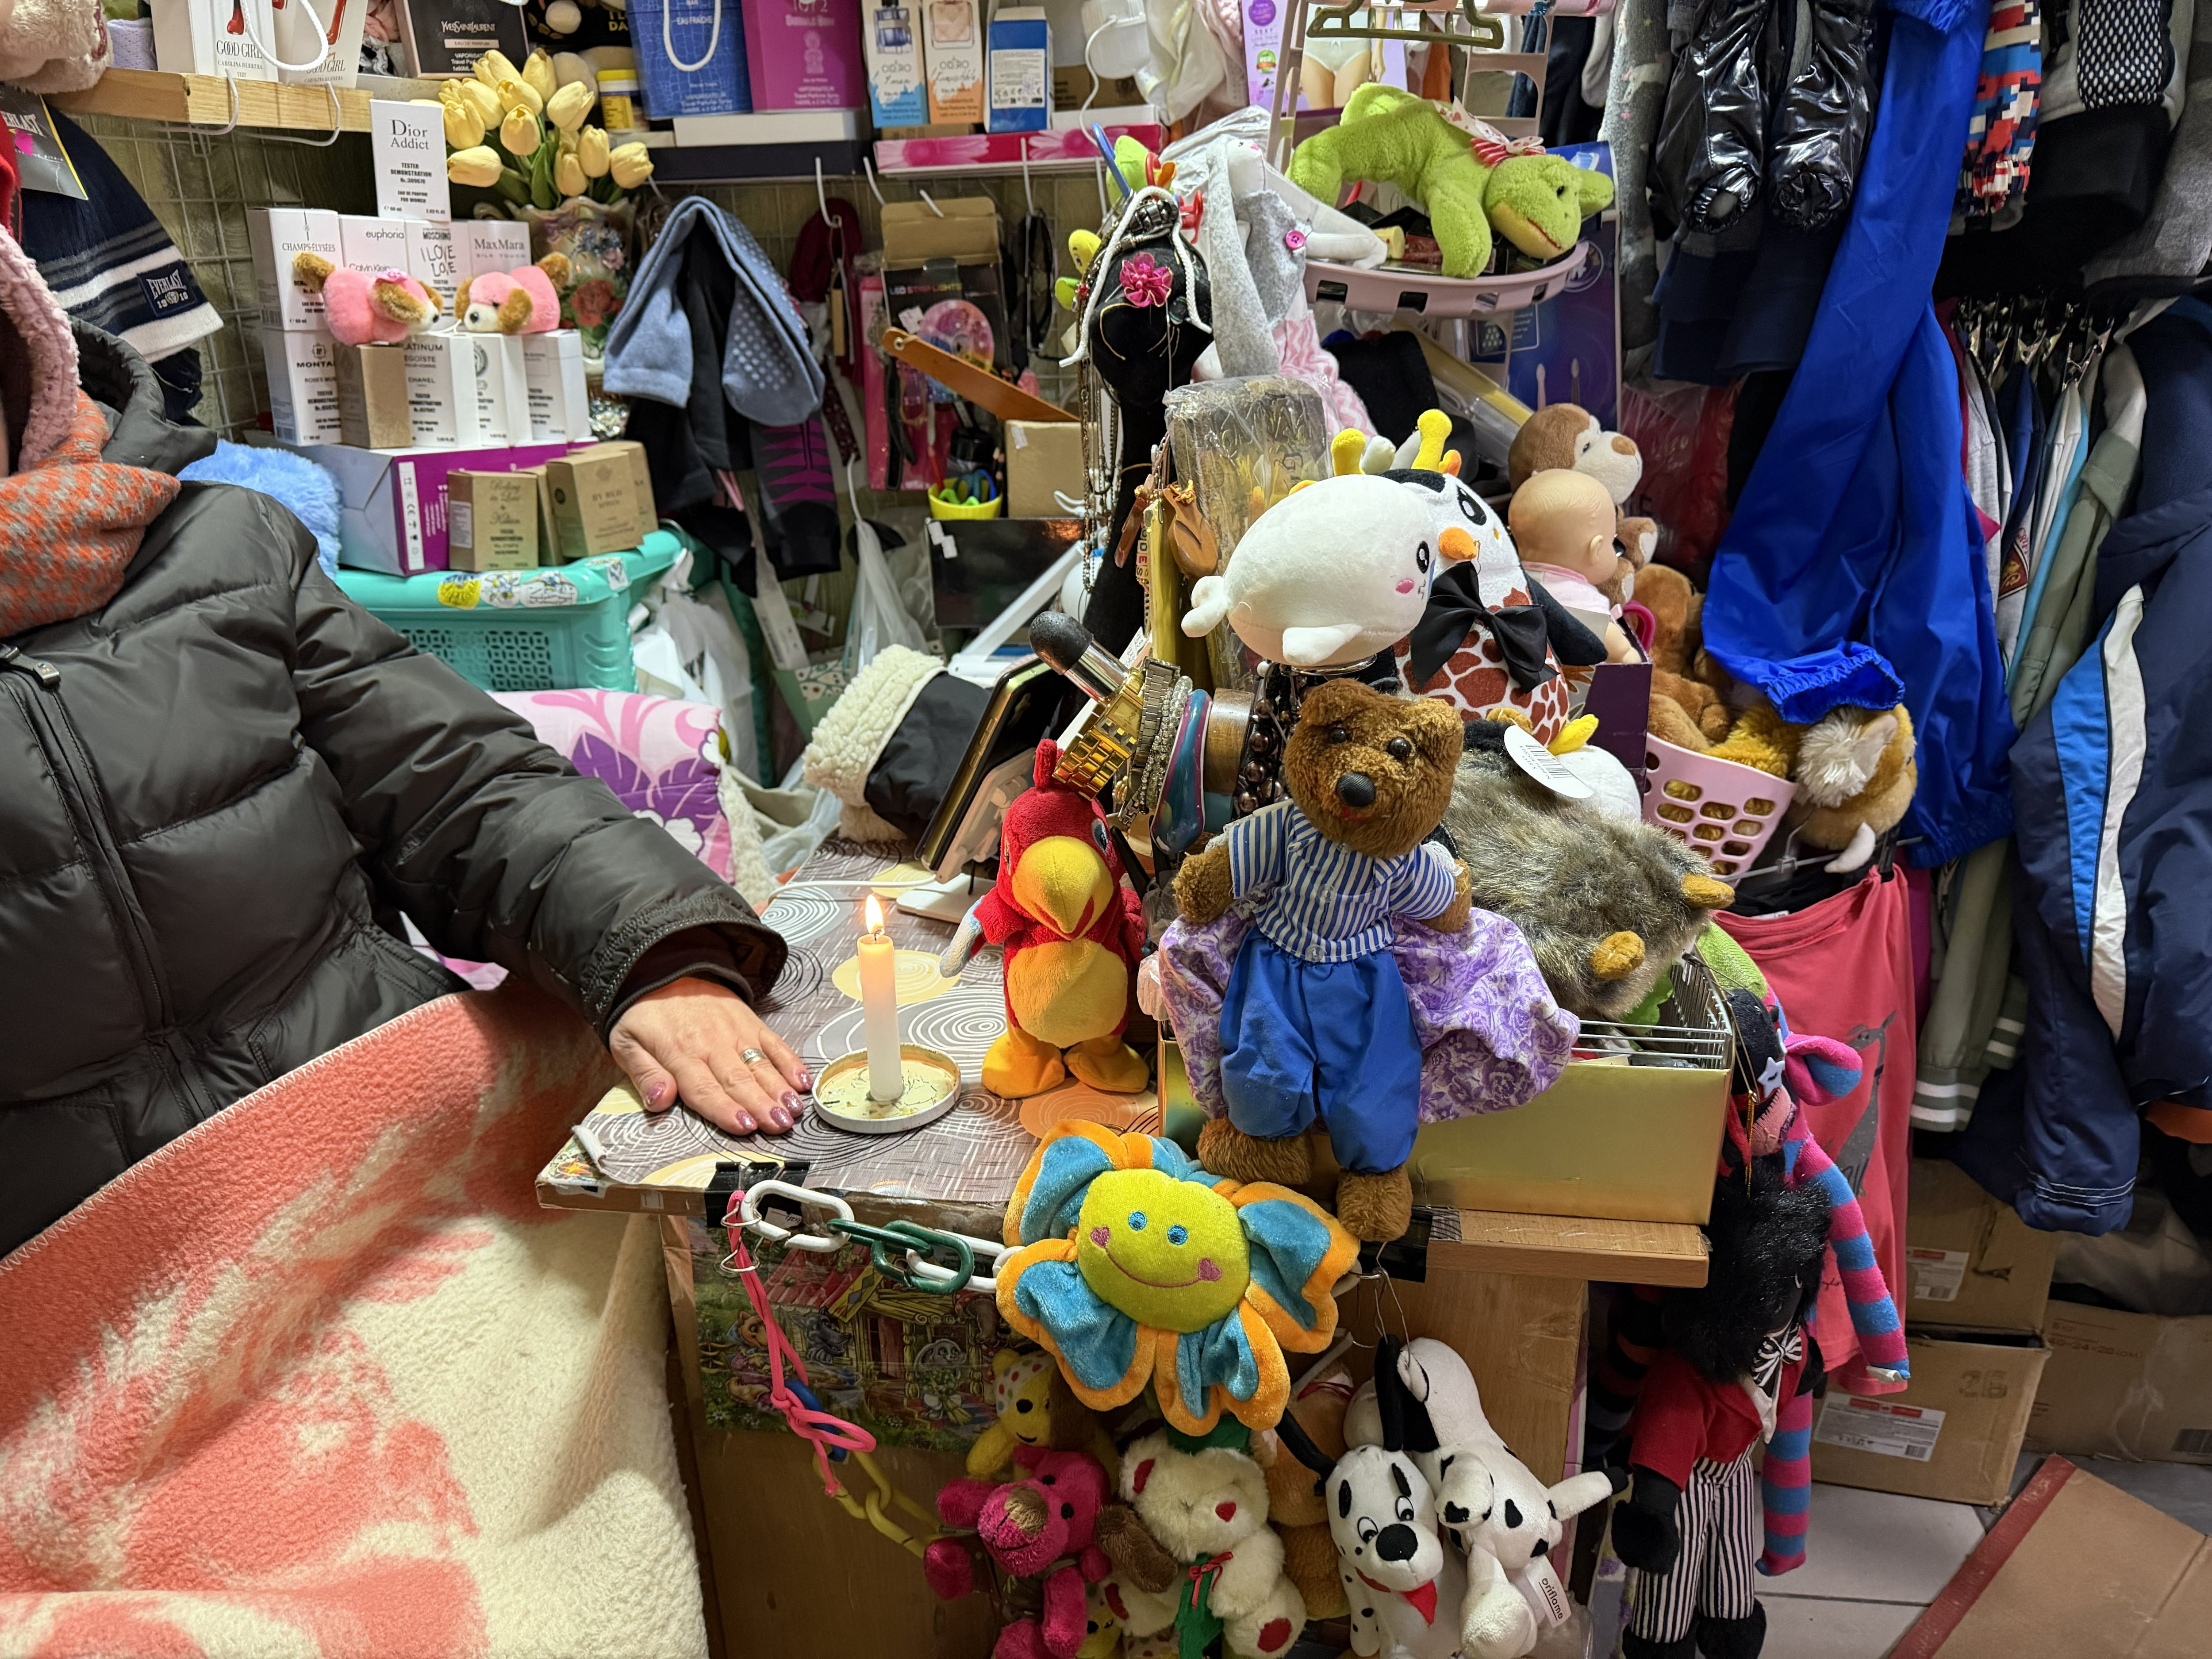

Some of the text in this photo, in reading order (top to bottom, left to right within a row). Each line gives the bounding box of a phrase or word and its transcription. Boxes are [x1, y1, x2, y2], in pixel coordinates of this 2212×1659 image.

[217, 39, 263, 59] GOOD GIRL
[327, 59, 345, 72] GIRL
[390, 119, 428, 138] Dior
[391, 137, 430, 150] Addict
[366, 228, 405, 241] euphoria
[146, 269, 187, 300] EVERLAST
[404, 342, 443, 352] ATINUM
[1542, 1578, 1563, 1619] oriflame
